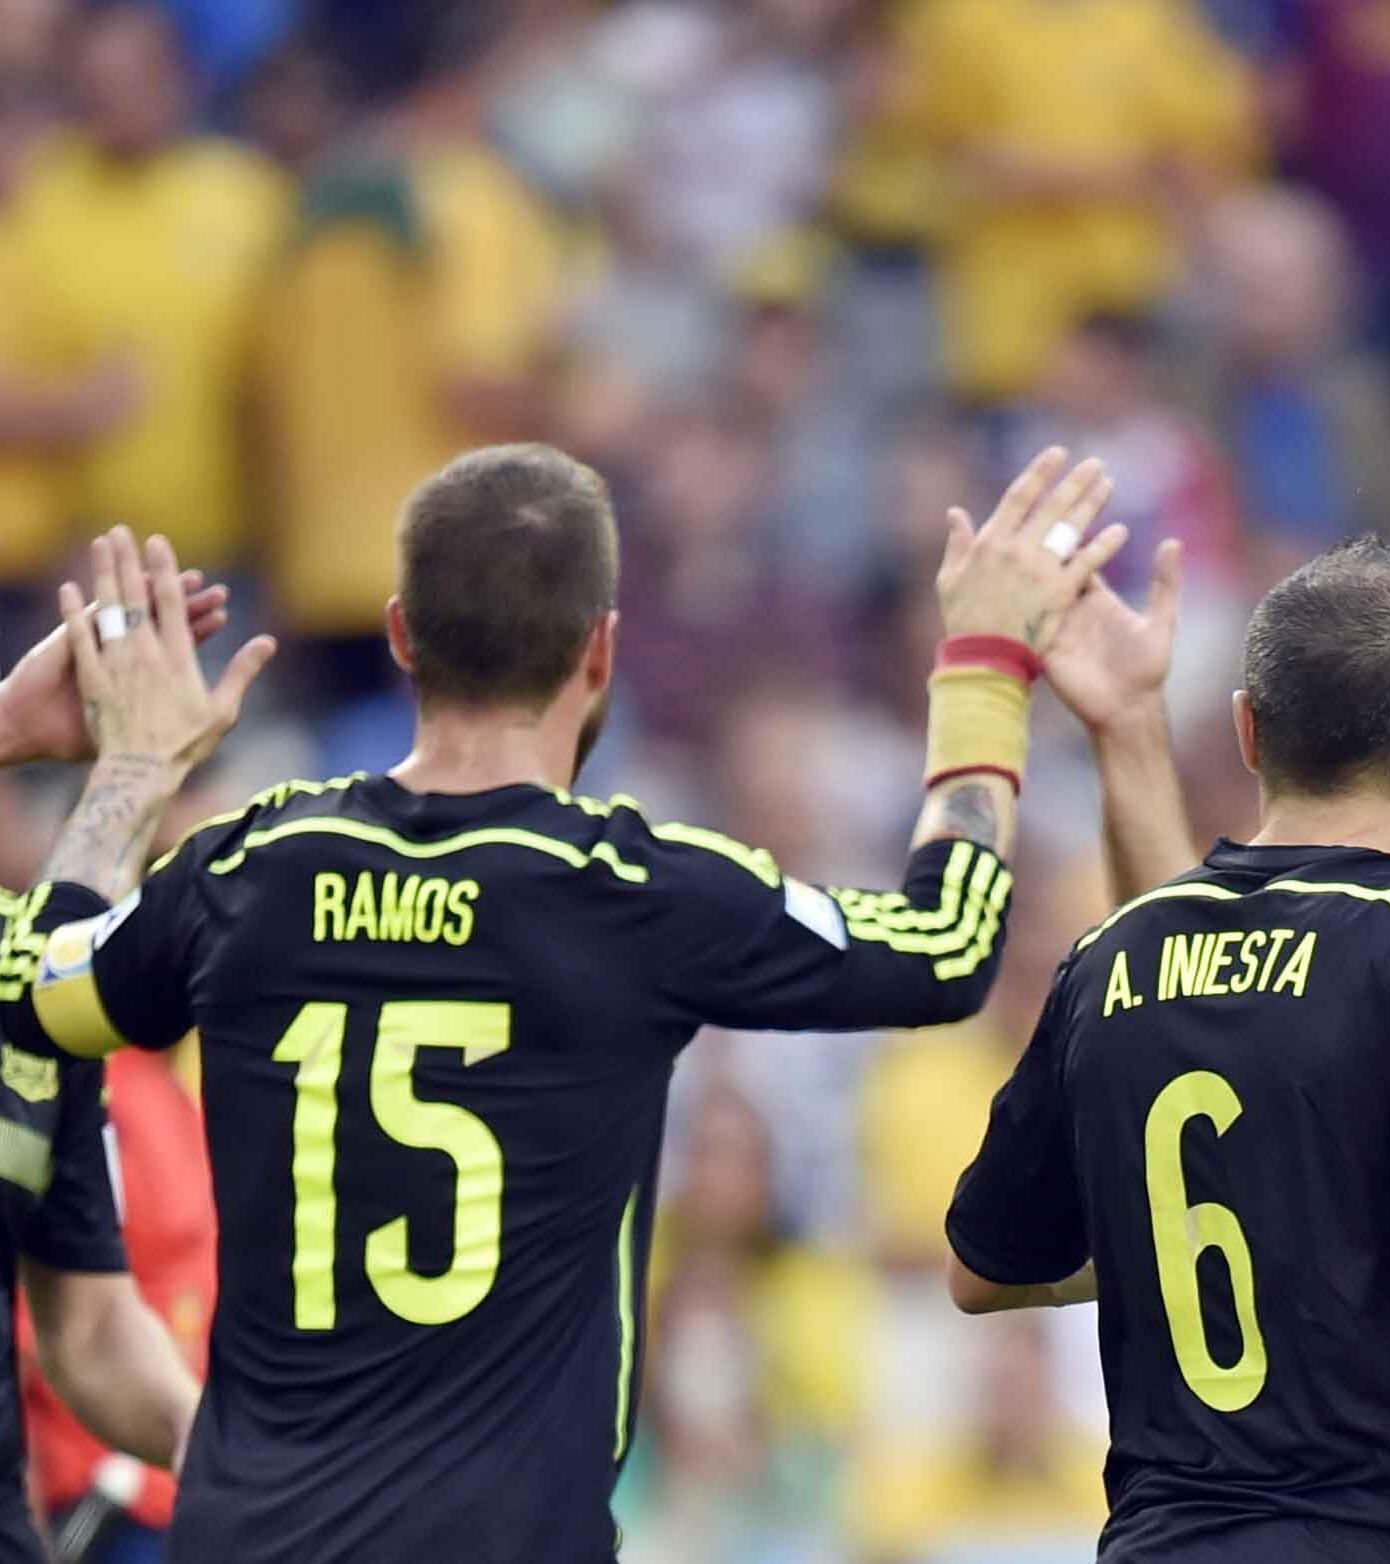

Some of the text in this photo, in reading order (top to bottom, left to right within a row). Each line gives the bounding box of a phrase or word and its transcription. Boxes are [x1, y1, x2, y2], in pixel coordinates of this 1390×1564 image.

[314, 870, 480, 946] RAMOS
[1103, 928, 1317, 1017] A. INIESTA
[272, 1000, 511, 1330] 15
[1145, 1070, 1268, 1412] 6
